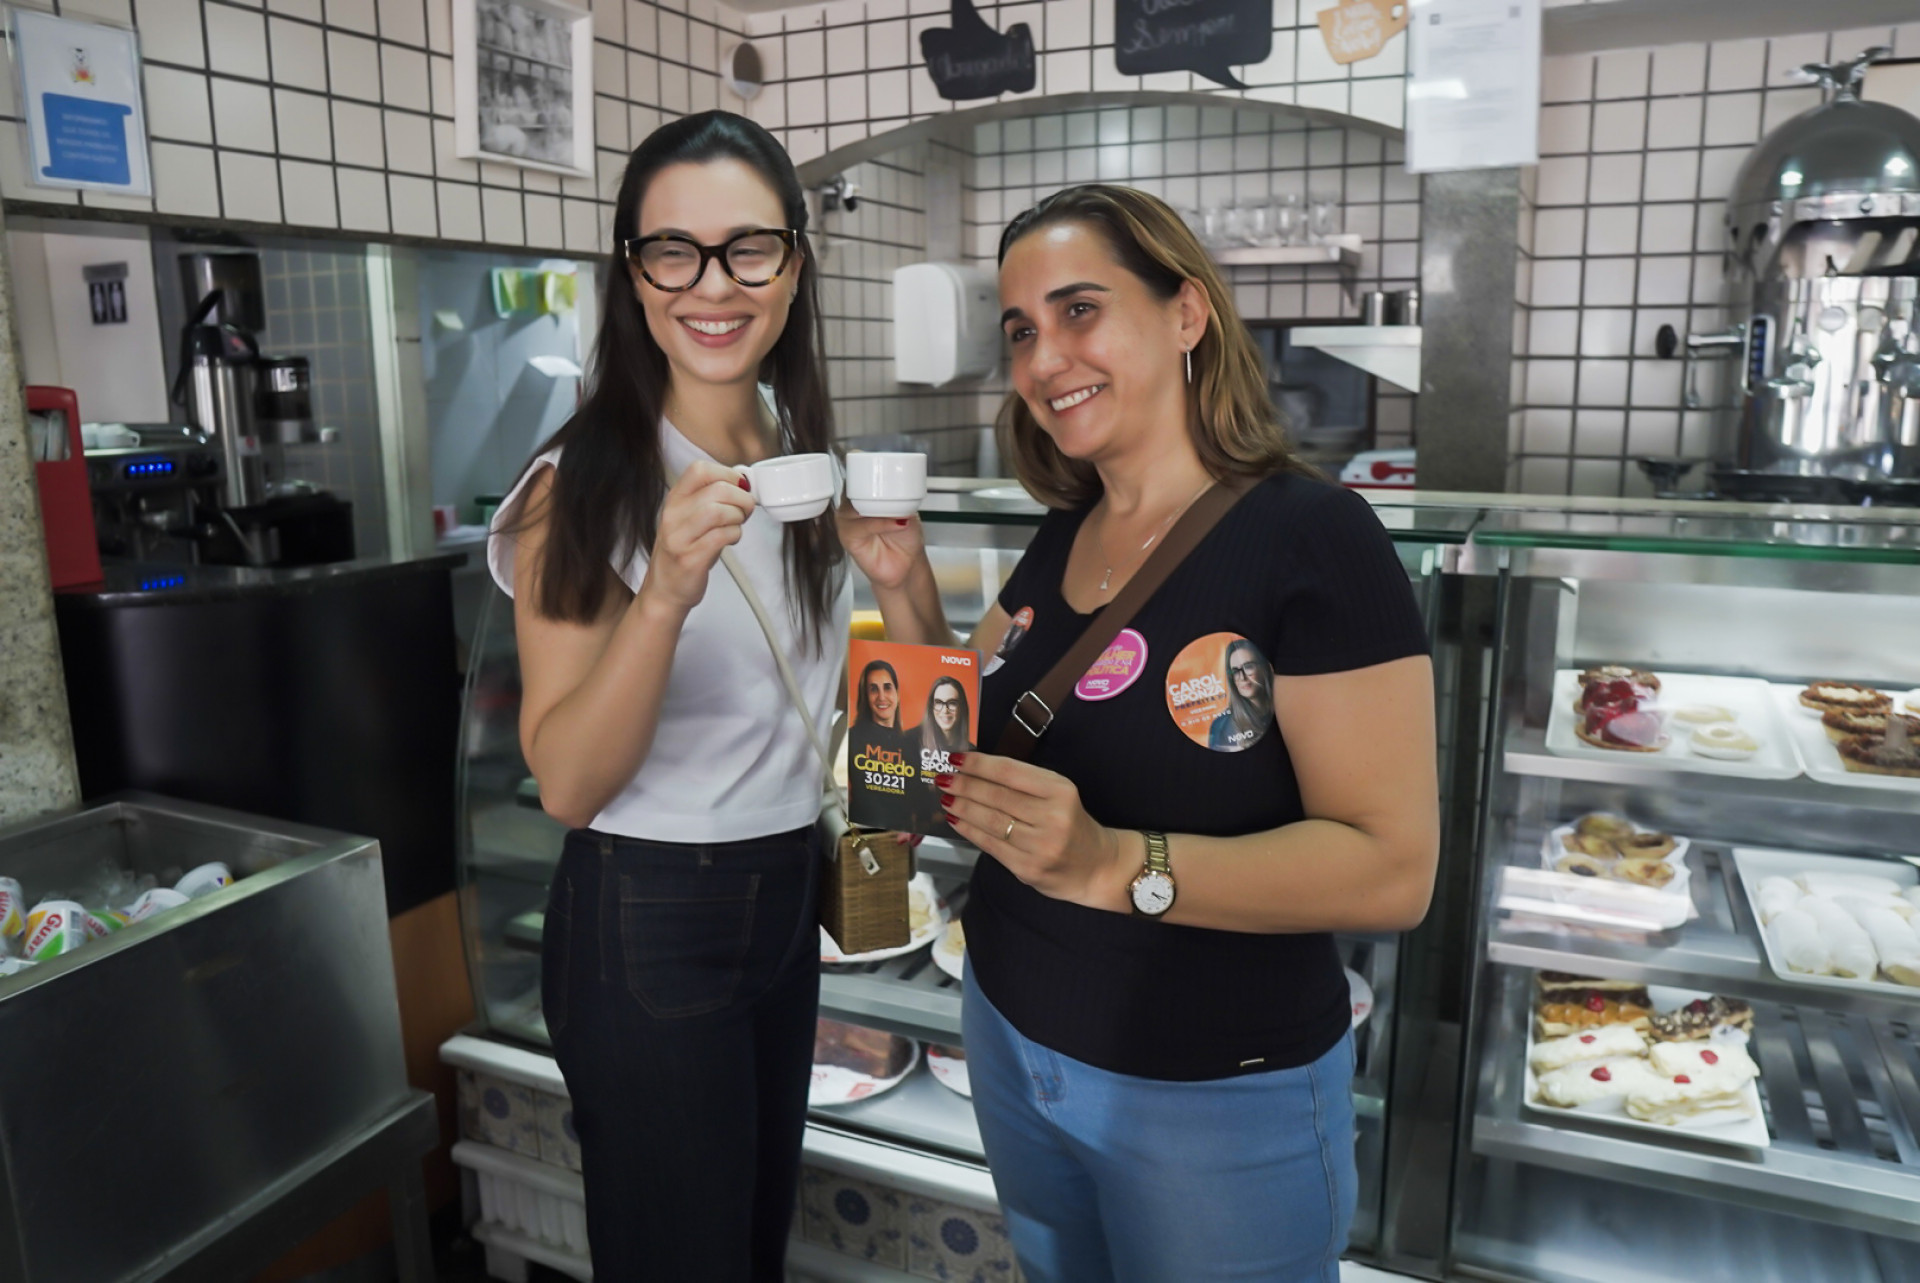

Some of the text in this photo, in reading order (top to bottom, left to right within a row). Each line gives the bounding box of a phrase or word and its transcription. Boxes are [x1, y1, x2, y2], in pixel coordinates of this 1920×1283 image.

[941, 655, 972, 666] NOVO
[1168, 673, 1222, 696] CAROL
[1172, 684, 1226, 706] SPONZA
[1228, 730, 1254, 743] NOVO
[866, 744, 902, 764] Mari
[920, 748, 949, 763] CAR
[854, 753, 915, 778] Canedo
[921, 761, 959, 773] SPON
[864, 771, 905, 789] 30221
